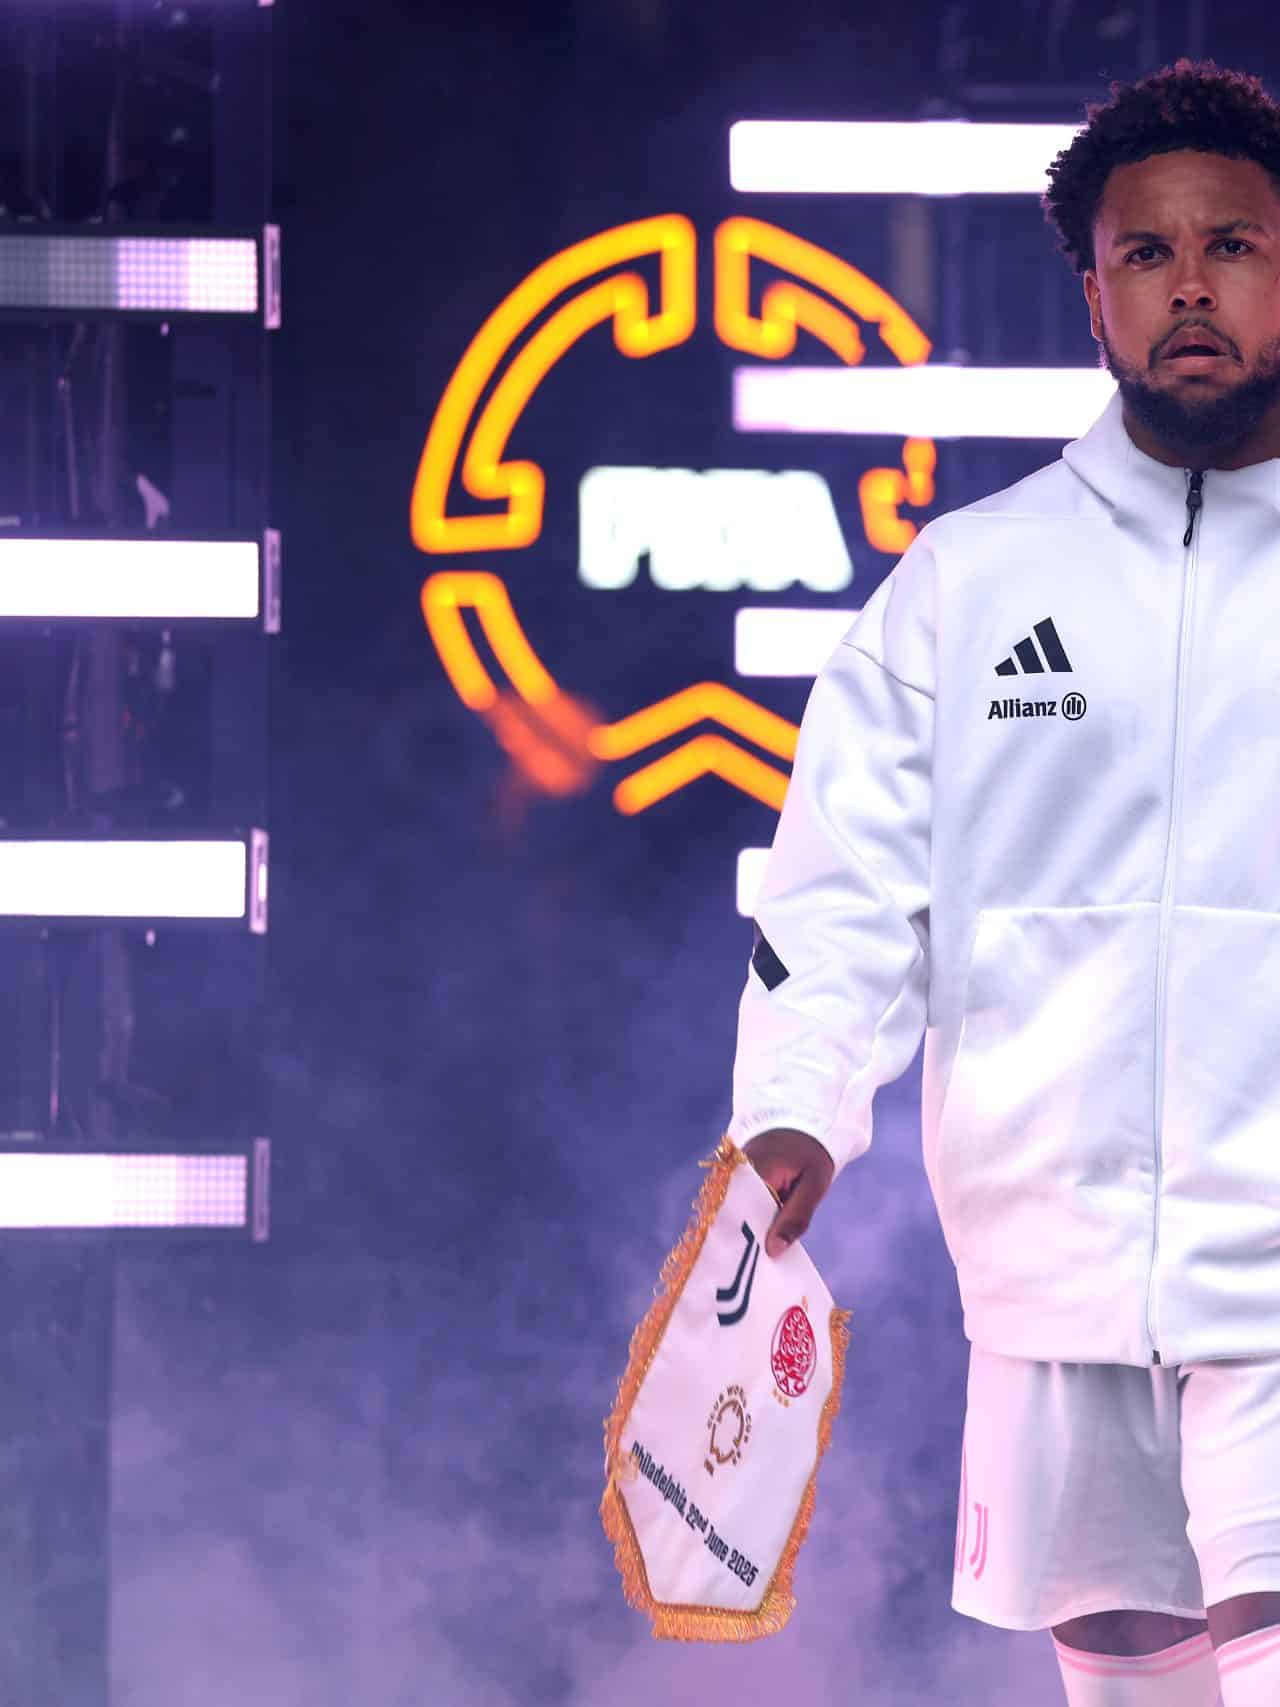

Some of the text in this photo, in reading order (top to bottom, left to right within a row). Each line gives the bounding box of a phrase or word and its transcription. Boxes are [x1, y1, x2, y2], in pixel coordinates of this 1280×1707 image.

[987, 697, 1057, 720] Allianz
[684, 1501, 708, 1532] 22nd
[702, 1526, 729, 1563] June
[727, 1547, 759, 1588] 2025
